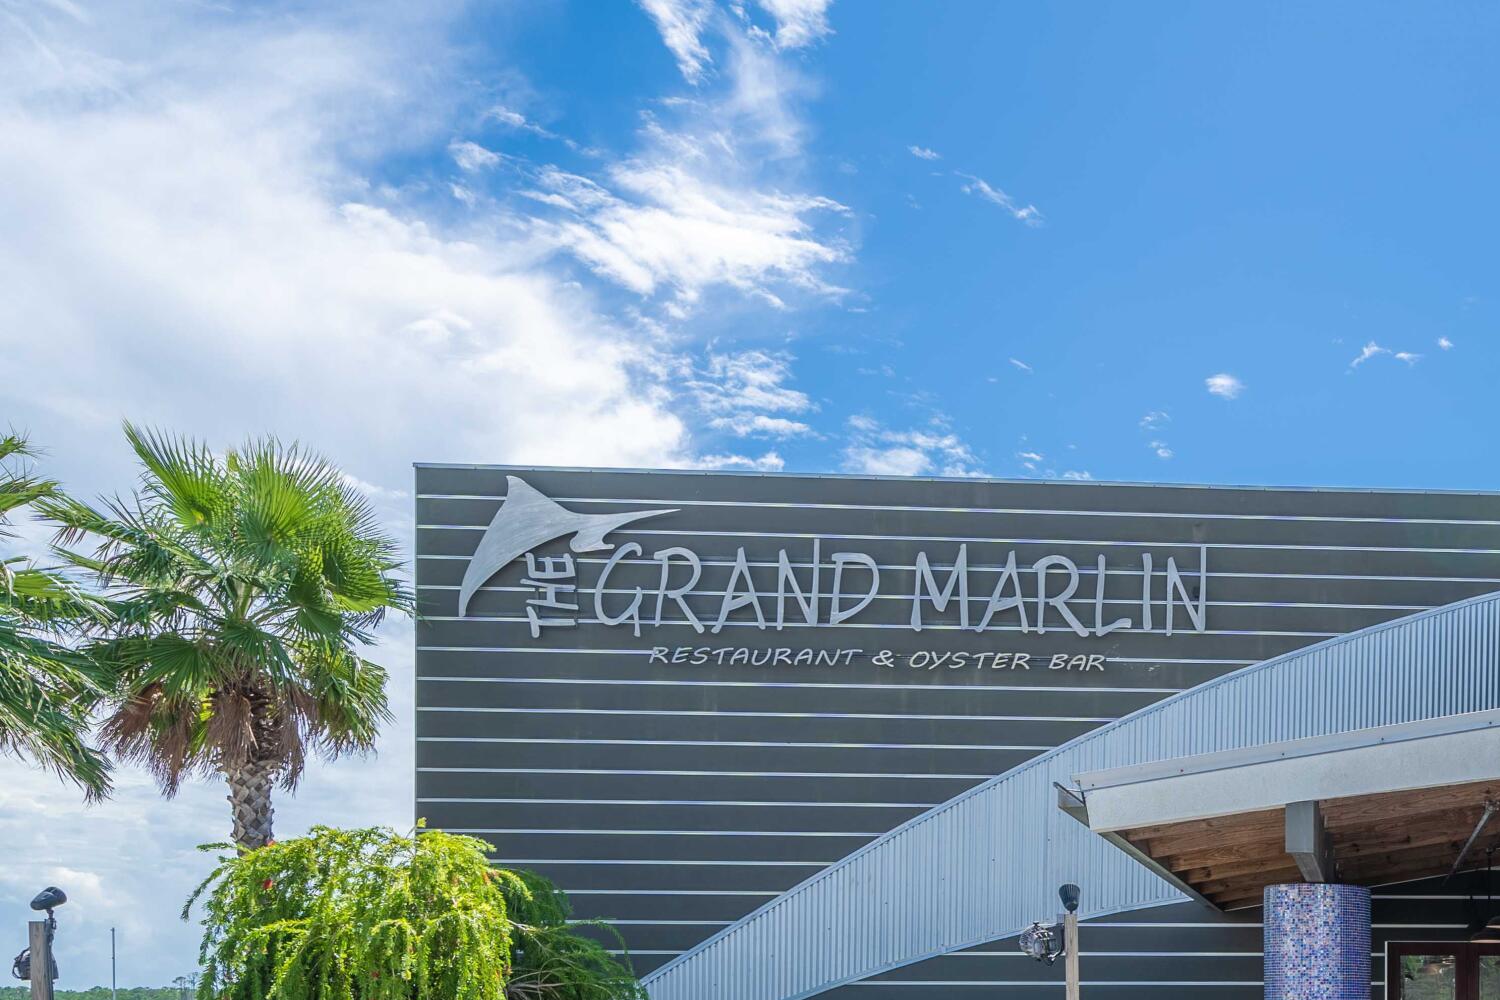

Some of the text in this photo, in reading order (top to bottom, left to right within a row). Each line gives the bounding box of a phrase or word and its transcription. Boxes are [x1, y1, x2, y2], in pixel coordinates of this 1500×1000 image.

[520, 552, 578, 638] THE
[594, 538, 1207, 637] GRAND MARLIN
[648, 646, 1106, 671] RESTAURANT & OYSTER BAR
